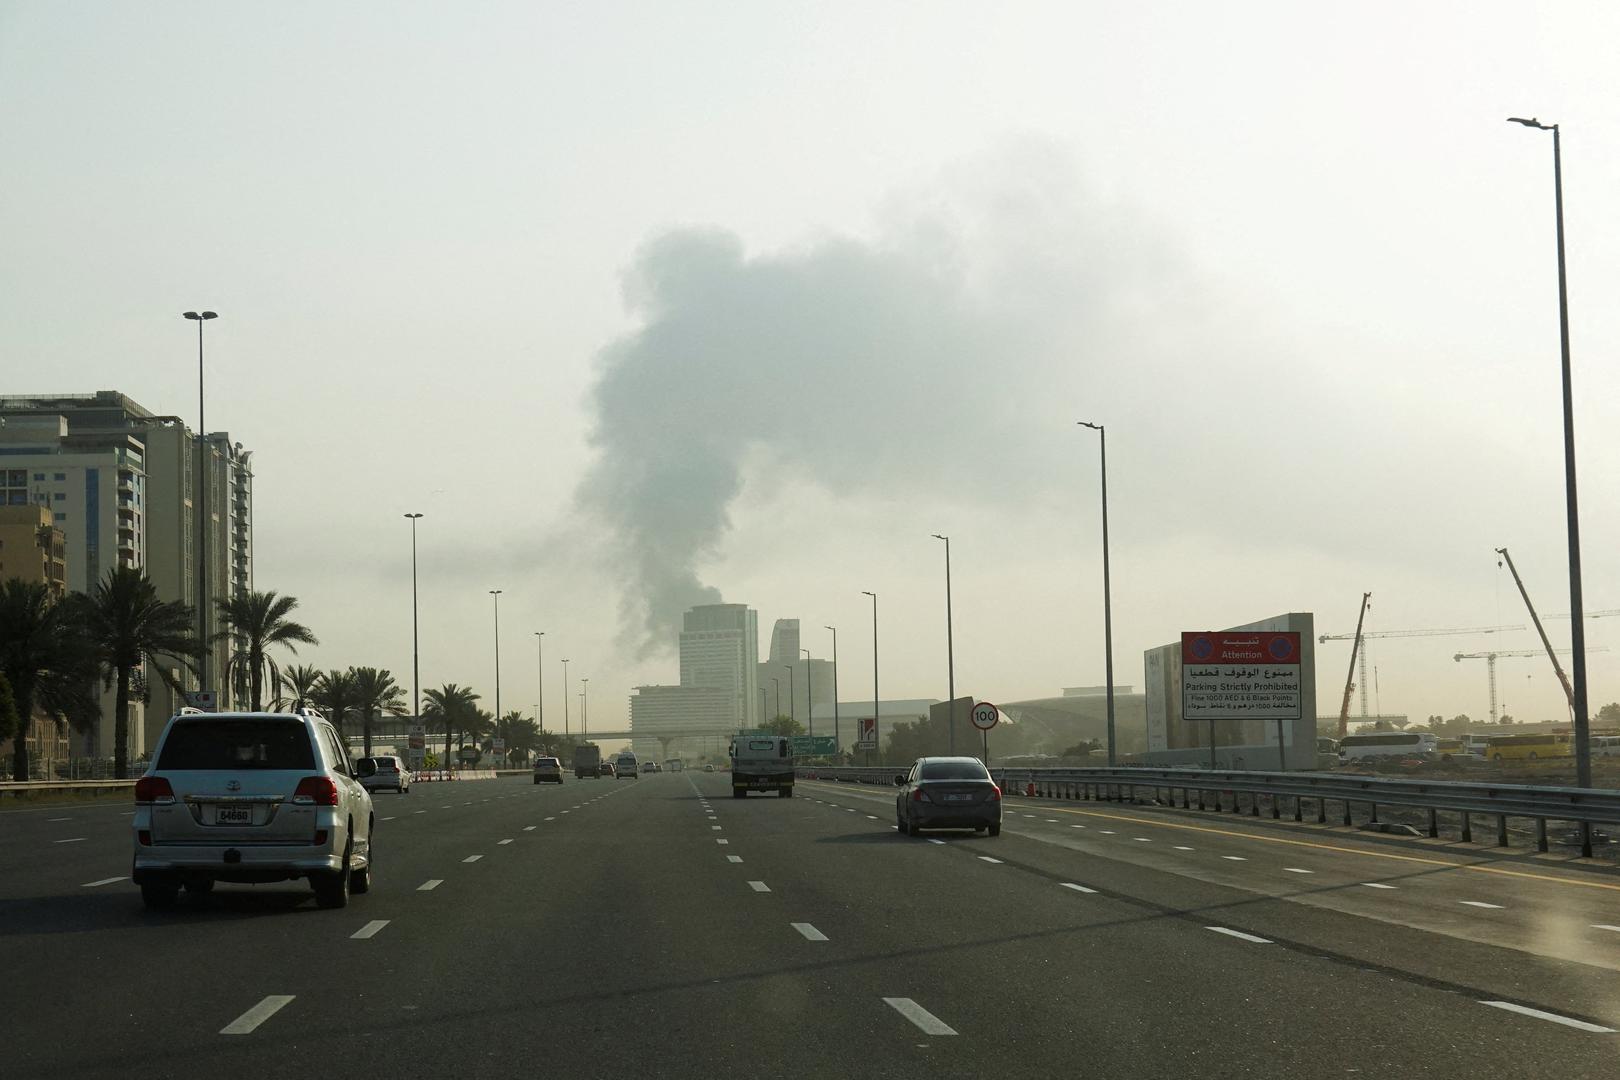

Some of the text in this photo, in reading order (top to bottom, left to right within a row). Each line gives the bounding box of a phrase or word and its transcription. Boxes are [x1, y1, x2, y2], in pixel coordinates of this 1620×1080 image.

[1223, 636, 1259, 647] تنبيه
[1222, 651, 1262, 659] Attention
[1224, 667, 1259, 679] الوقوف
[1264, 668, 1293, 679] ممنوع
[1186, 682, 1298, 692] Parking Strictly Prohibited
[976, 711, 995, 721] 100
